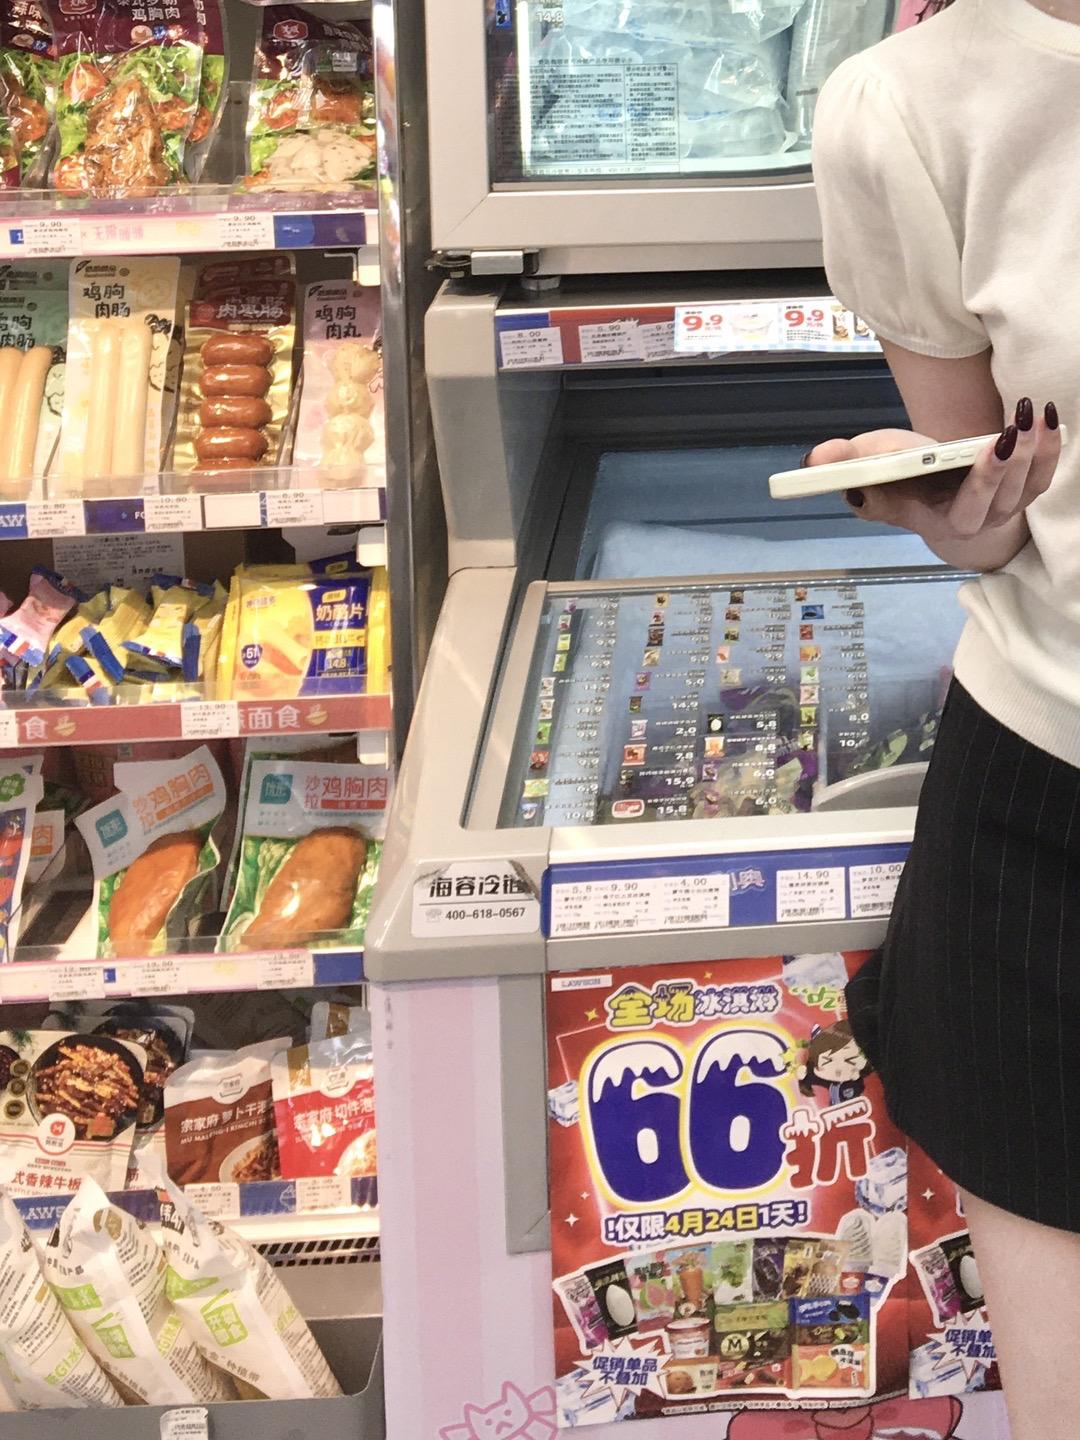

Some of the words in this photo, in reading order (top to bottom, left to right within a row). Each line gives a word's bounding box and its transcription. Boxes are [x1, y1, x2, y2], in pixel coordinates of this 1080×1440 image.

[132, 6, 181, 23] 鸡胸肉
[82, 282, 126, 301] 鸡胸
[95, 301, 131, 320] 肉肠
[314, 304, 357, 323] 鸡胸
[784, 308, 825, 328] 9.9
[325, 323, 362, 340] 肉丸
[683, 313, 724, 332] 9.9
[316, 602, 364, 621] 奶酪片
[147, 763, 213, 809] 鸡胸肉
[321, 775, 389, 799] 鸡胸肉
[611, 882, 638, 892] 9.90
[680, 877, 708, 887] 4.00
[444, 906, 526, 923] 400-618-0567
[608, 983, 780, 1027] 全场冰淇淋
[592, 1355, 659, 1372] 促销单品
[599, 1370, 649, 1386] 不叠加
